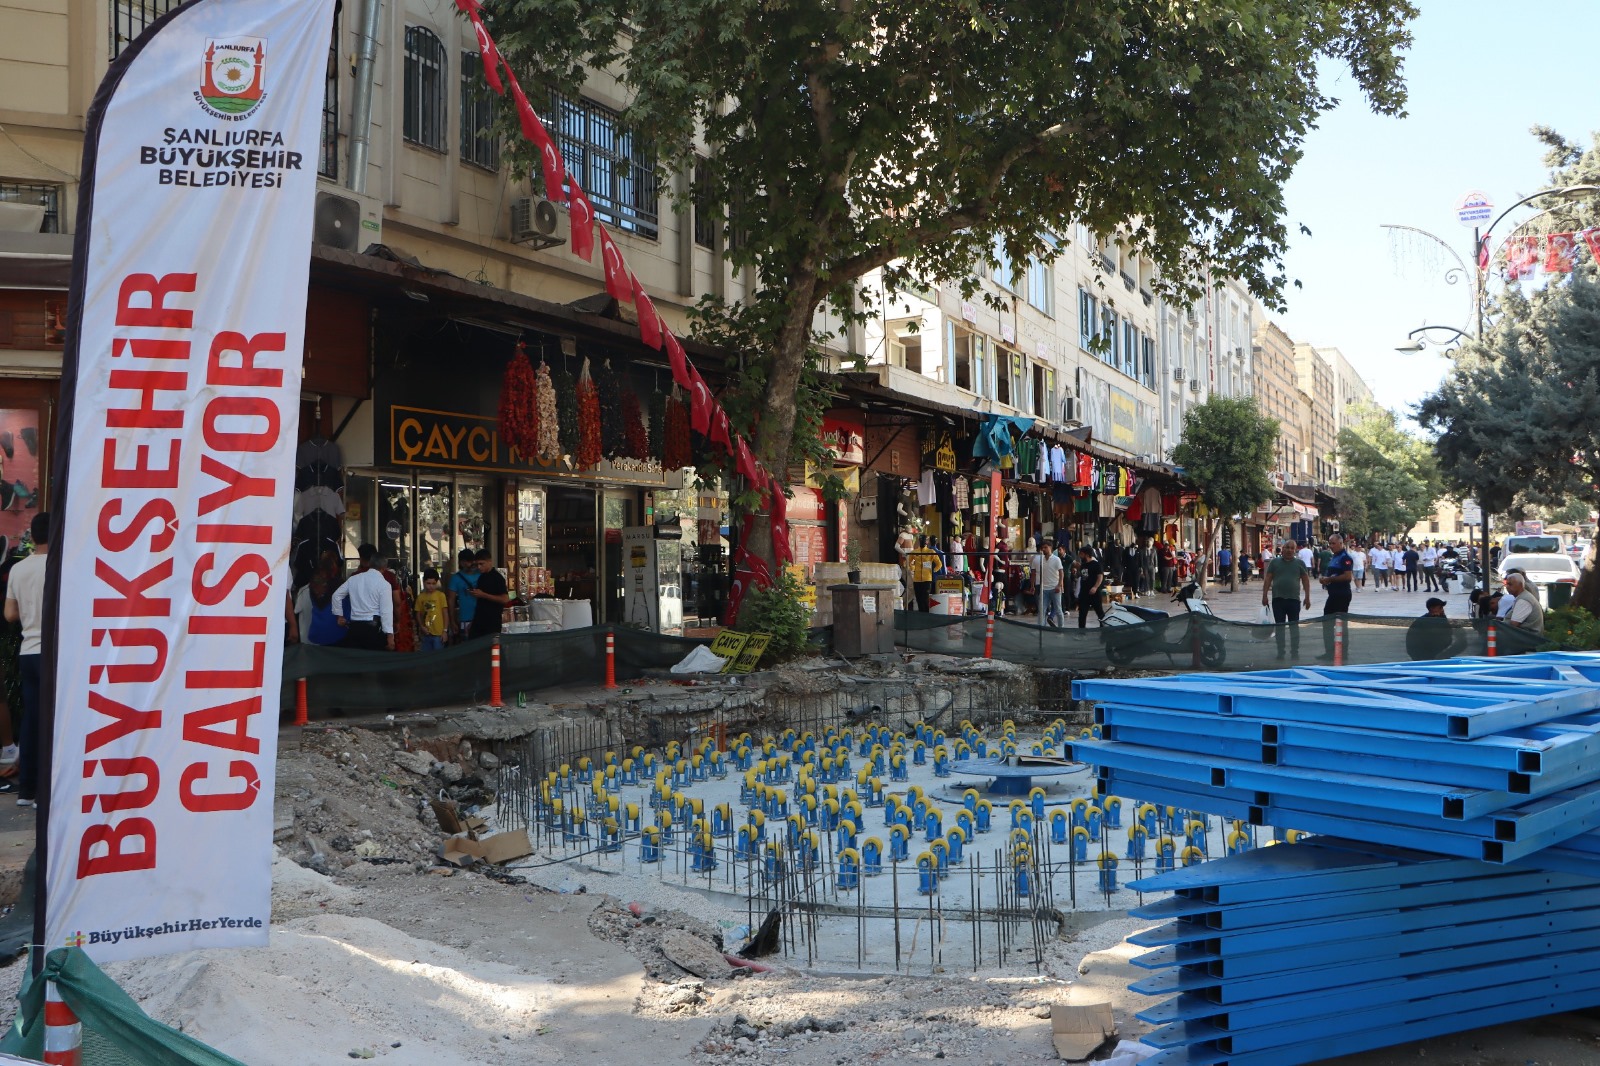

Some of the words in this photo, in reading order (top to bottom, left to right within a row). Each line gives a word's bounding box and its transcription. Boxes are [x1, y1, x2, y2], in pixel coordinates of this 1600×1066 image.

[193, 90, 232, 121] BÜYÜKŞEHİR
[163, 127, 284, 147] ŞANLIURFA
[140, 146, 303, 171] BÜYÜKŞEHİR
[158, 169, 282, 188] BELEDİYESİ
[399, 418, 498, 462] ÇAYCI
[611, 459, 647, 473] Perakende
[76, 272, 197, 880] BÜYÜKŞEHİR
[179, 330, 286, 812] ÇALIŞIYOR
[716, 635, 741, 651] ÇAYCI
[745, 637, 767, 651] ÇAYCI
